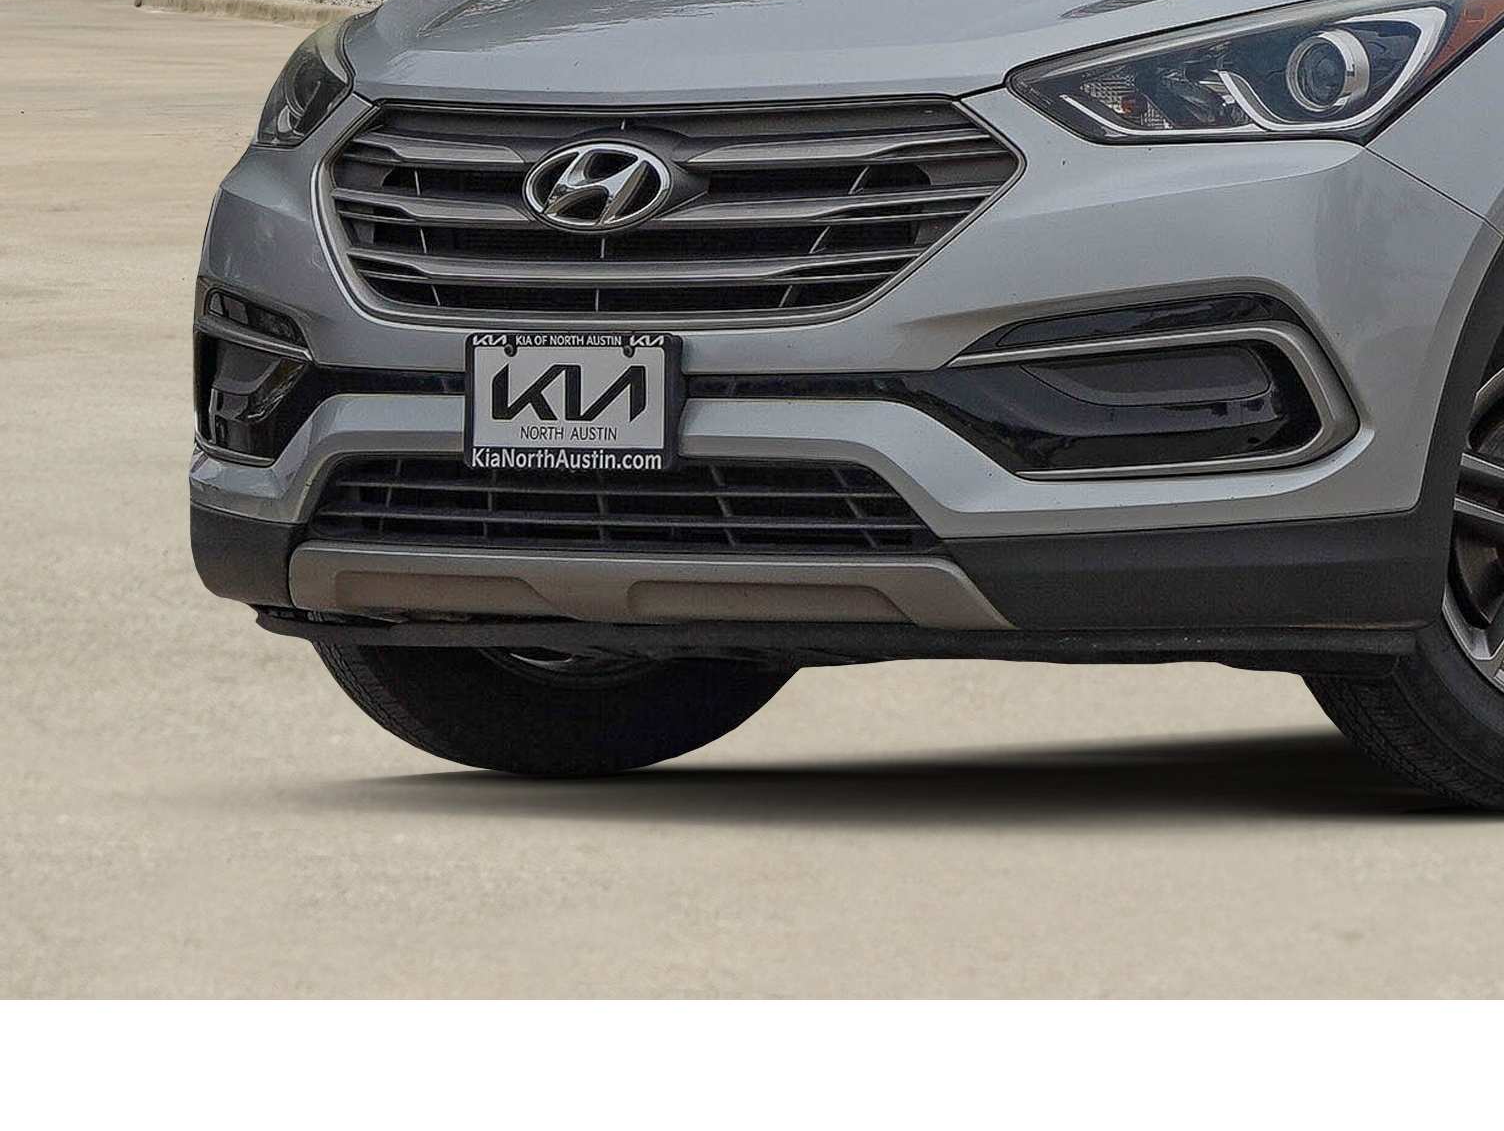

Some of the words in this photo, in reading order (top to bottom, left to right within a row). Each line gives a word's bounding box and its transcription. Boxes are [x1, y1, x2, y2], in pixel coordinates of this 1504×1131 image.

[515, 335, 533, 346] KIA
[534, 335, 548, 346] OF
[549, 335, 585, 346] NORTH
[586, 335, 622, 346] AUSTIN
[520, 426, 564, 440] NORTH
[570, 426, 618, 441] AUSTIN
[471, 448, 662, 469] KiaNorthAustin.com
